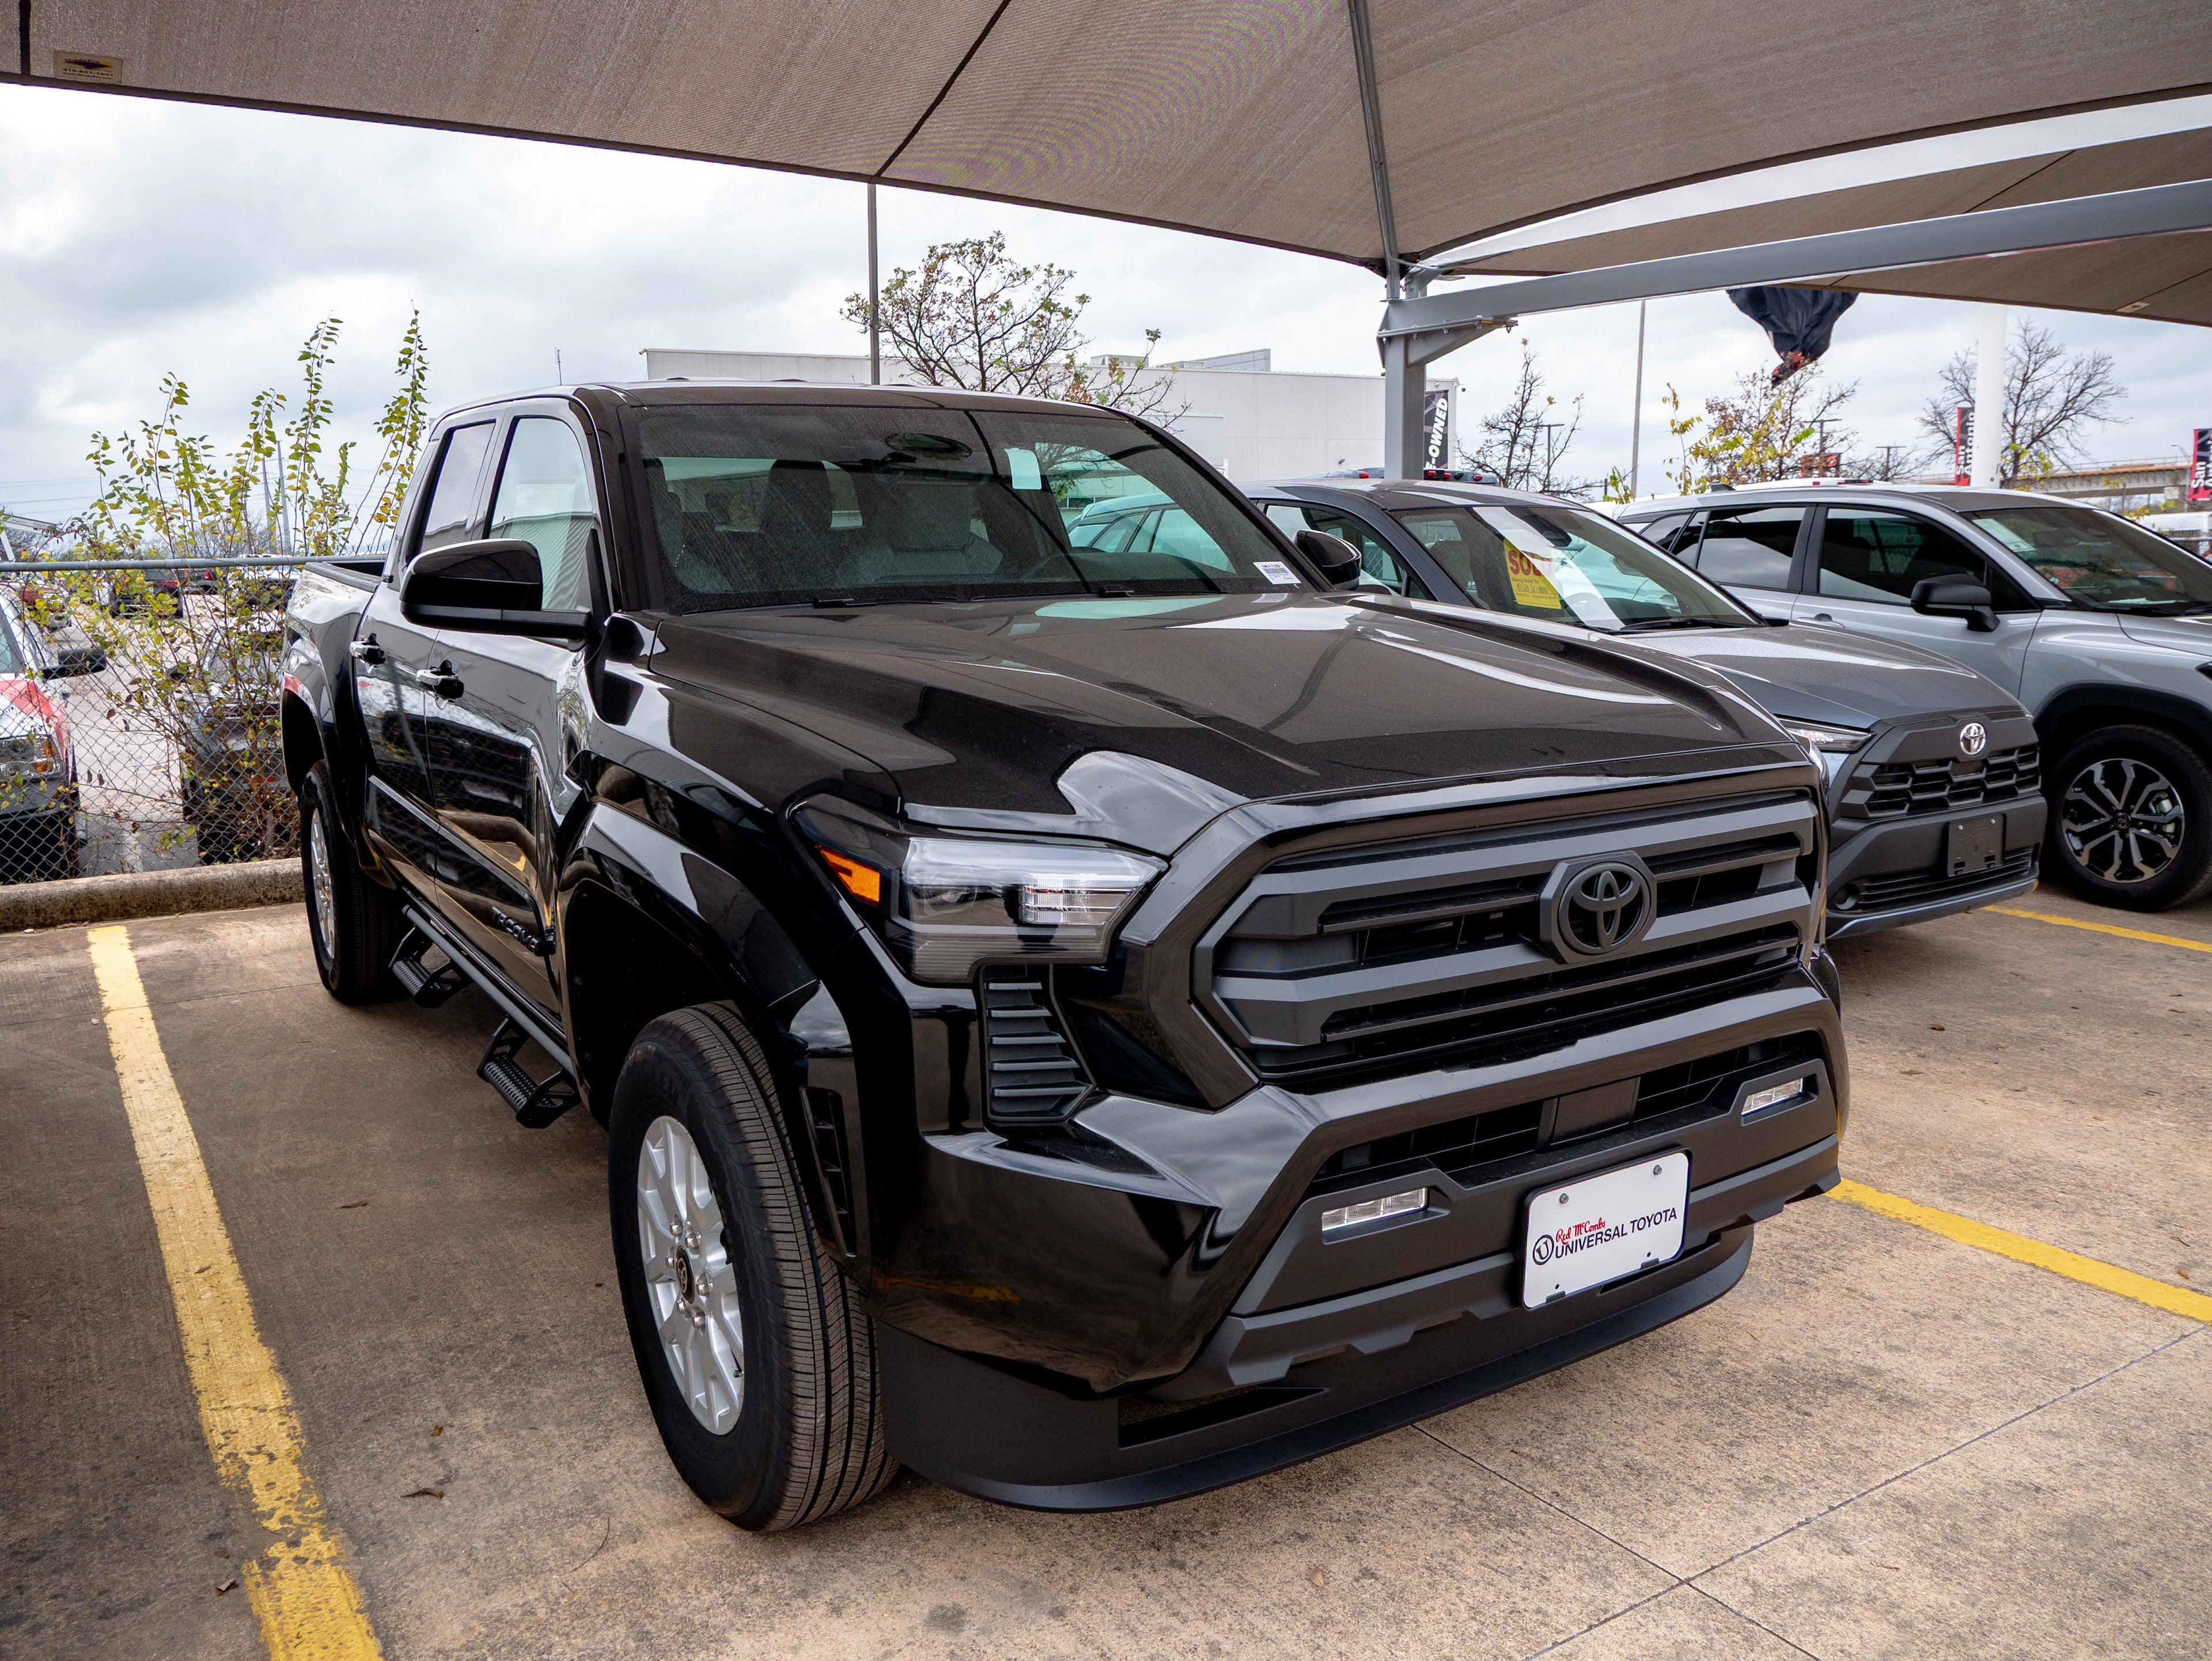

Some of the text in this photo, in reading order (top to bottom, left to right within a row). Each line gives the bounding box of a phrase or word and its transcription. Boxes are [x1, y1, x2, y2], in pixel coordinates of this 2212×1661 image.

[1964, 412, 1975, 476] Antonio
[1956, 445, 1965, 476] San
[2191, 461, 2206, 489] San
[1555, 1208, 1677, 1259] UNIVERSAL TOYOTA
[1556, 1228, 1571, 1245] Red
